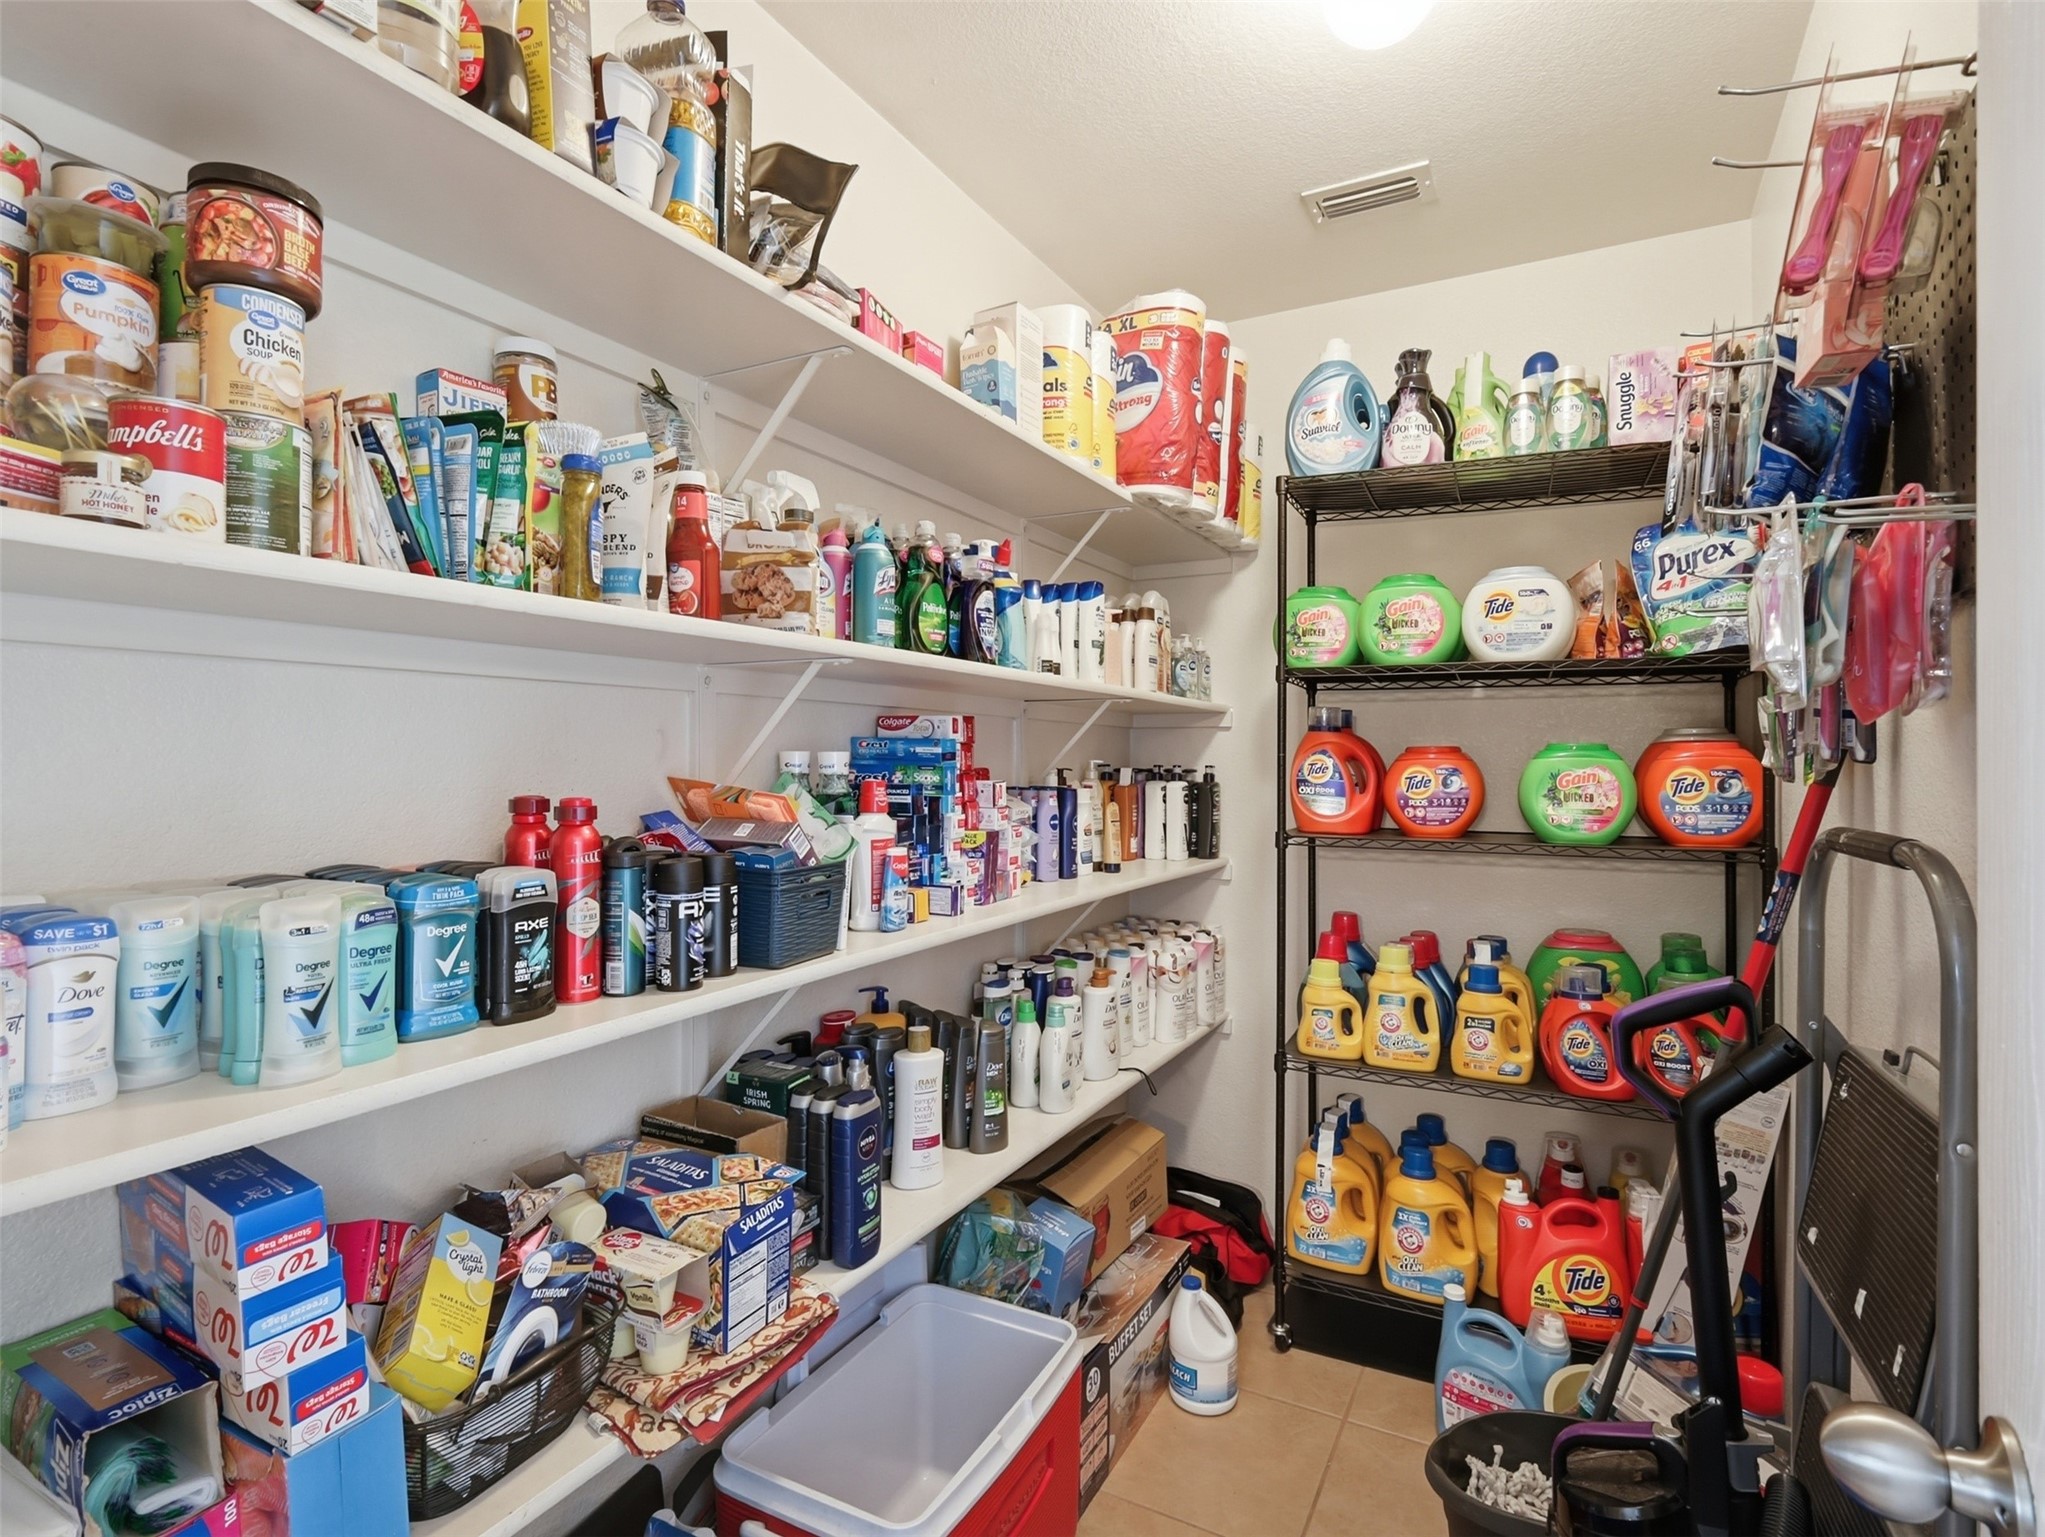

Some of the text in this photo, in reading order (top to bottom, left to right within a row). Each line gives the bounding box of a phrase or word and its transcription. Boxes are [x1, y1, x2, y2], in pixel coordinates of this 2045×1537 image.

[284, 229, 315, 254] BROTH
[284, 241, 310, 263] BASE
[284, 252, 307, 272] BEEF
[73, 302, 150, 337] Pumpkin
[1120, 317, 1137, 332] XL
[243, 329, 302, 362] Chicken
[247, 347, 273, 360] SOUP
[442, 371, 506, 396] America's Favorite
[443, 388, 505, 412] JIFFY
[1616, 372, 1635, 431] Snuggle
[82, 499, 135, 513] HOT HONEY
[603, 534, 627, 543] SPY
[1634, 538, 1651, 551] 66
[1658, 540, 1736, 580] Purex
[1386, 599, 1423, 618] Gain
[1485, 598, 1514, 618] Tide
[1297, 609, 1329, 626] Gain
[1391, 618, 1419, 629] WICKED
[879, 717, 911, 727] Colgate
[858, 741, 889, 749] Crest
[1307, 762, 1330, 777] Tide
[1405, 776, 1432, 791] Tide
[1556, 770, 1598, 790] Gain
[1670, 776, 1705, 798] Tide
[1564, 790, 1595, 803] WICKED
[34, 923, 109, 940] SAVE $1
[426, 923, 467, 939] Degree
[514, 916, 549, 933] AXE
[47, 941, 101, 953] twin pack
[350, 944, 392, 960] Degree
[143, 957, 185, 972] Degree
[296, 960, 331, 973] Degree
[350, 961, 372, 969] ULTRA
[57, 984, 105, 1004] Dove
[1568, 1037, 1591, 1050] Tide
[1656, 1040, 1677, 1052] Tide
[1666, 1062, 1692, 1070] BOOST
[745, 1087, 768, 1099] IRISH
[743, 1097, 772, 1109] SPRING
[646, 1156, 709, 1180] SALADITAS
[739, 1196, 785, 1234] SALADITAS
[1305, 1231, 1329, 1240] CLEAN
[1310, 1226, 1325, 1234] OXI
[254, 1227, 312, 1253] Storage Bags
[449, 1248, 483, 1264] Crystal
[1402, 1255, 1418, 1264] OXI
[462, 1260, 484, 1276] light
[1398, 1262, 1423, 1271] CLEAN
[1565, 1267, 1606, 1294] Tide
[531, 1287, 570, 1299] BATHROOM
[261, 1297, 329, 1330] Freezer Bags
[1108, 1300, 1153, 1366] BUFFET SET
[1087, 1368, 1100, 1394] 30
[1171, 1365, 1191, 1382] EACH
[305, 1377, 355, 1409] Storage Bags
[108, 1385, 178, 1420] ziploc
